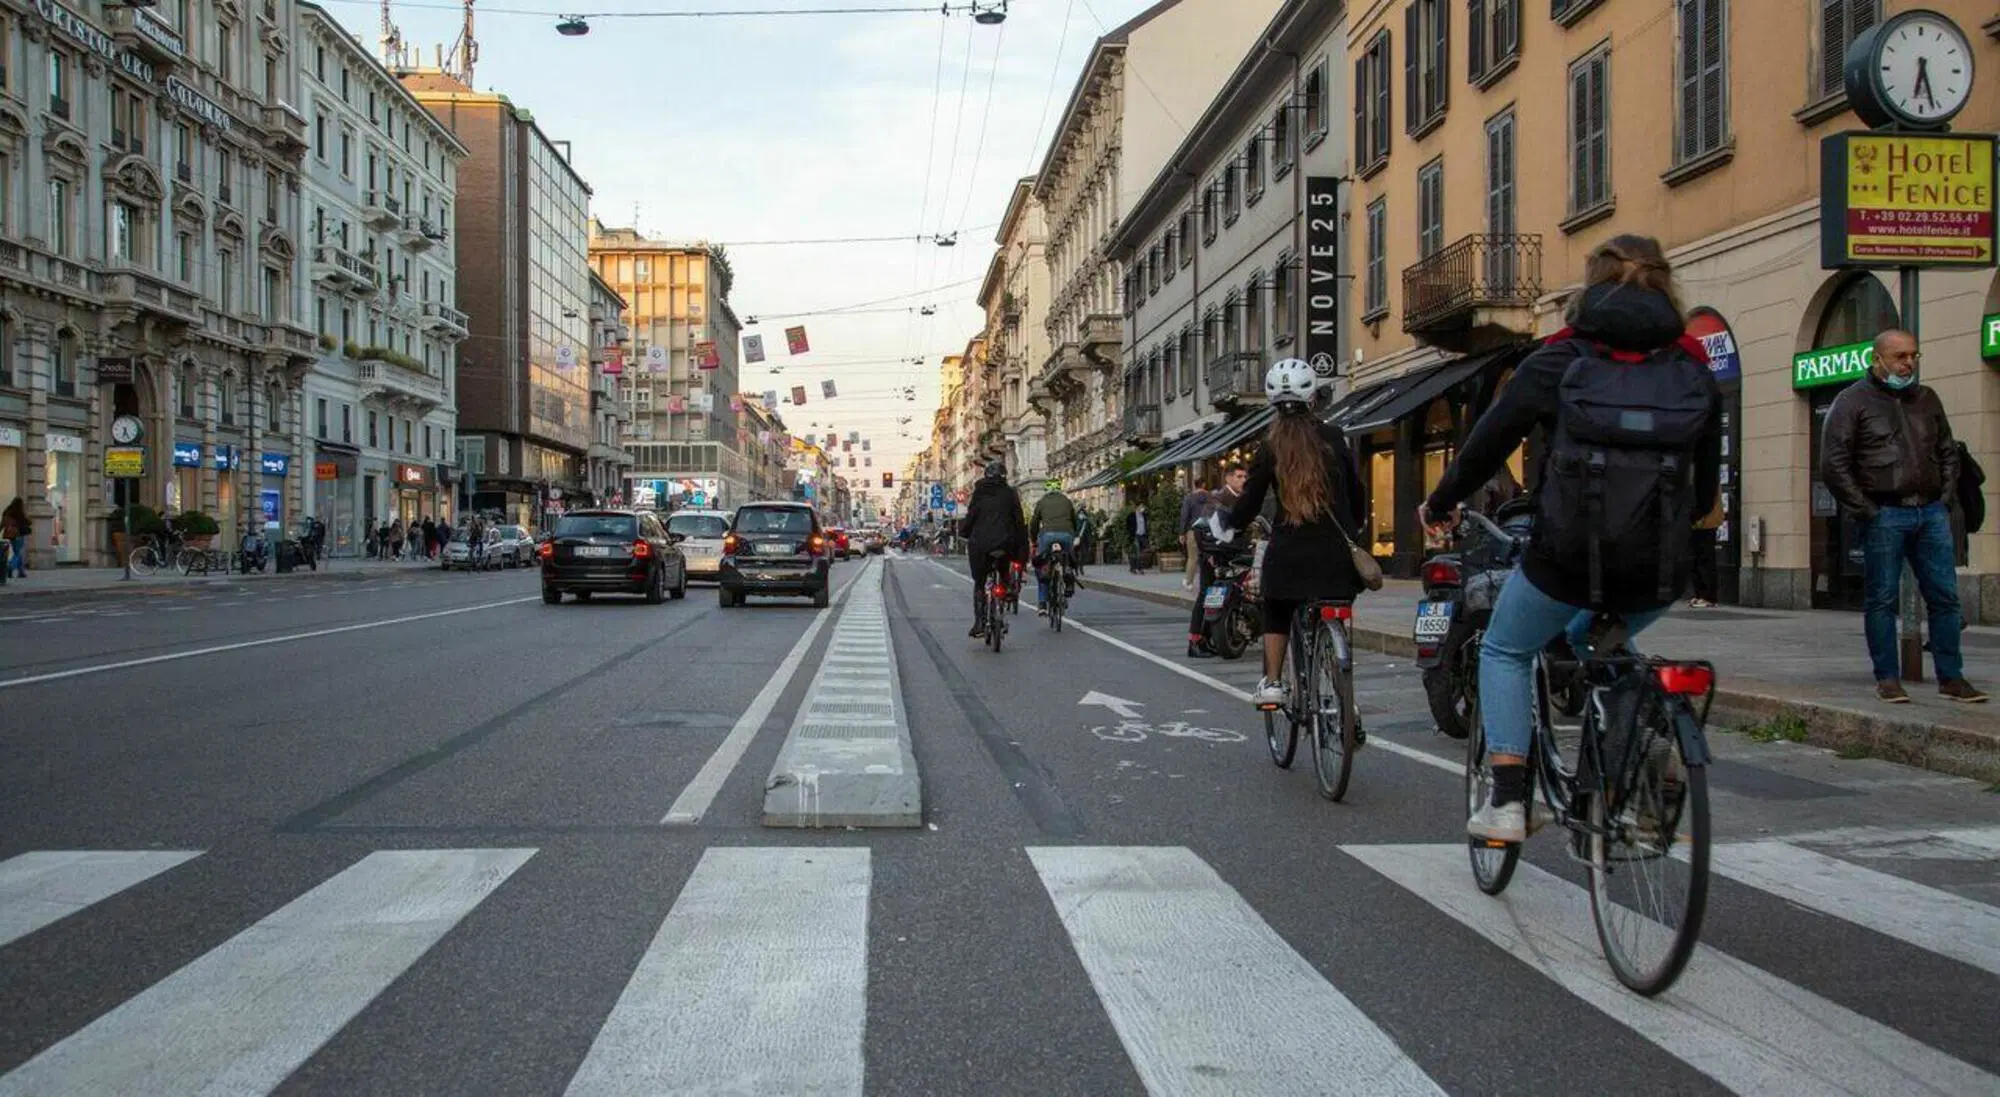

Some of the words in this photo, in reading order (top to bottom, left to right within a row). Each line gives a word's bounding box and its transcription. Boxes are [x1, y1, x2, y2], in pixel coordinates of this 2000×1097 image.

[1867, 225, 1971, 236] www.hotelfenice.it
[1311, 193, 1334, 334] NOVE25
[1797, 346, 1875, 380] FARMAC
